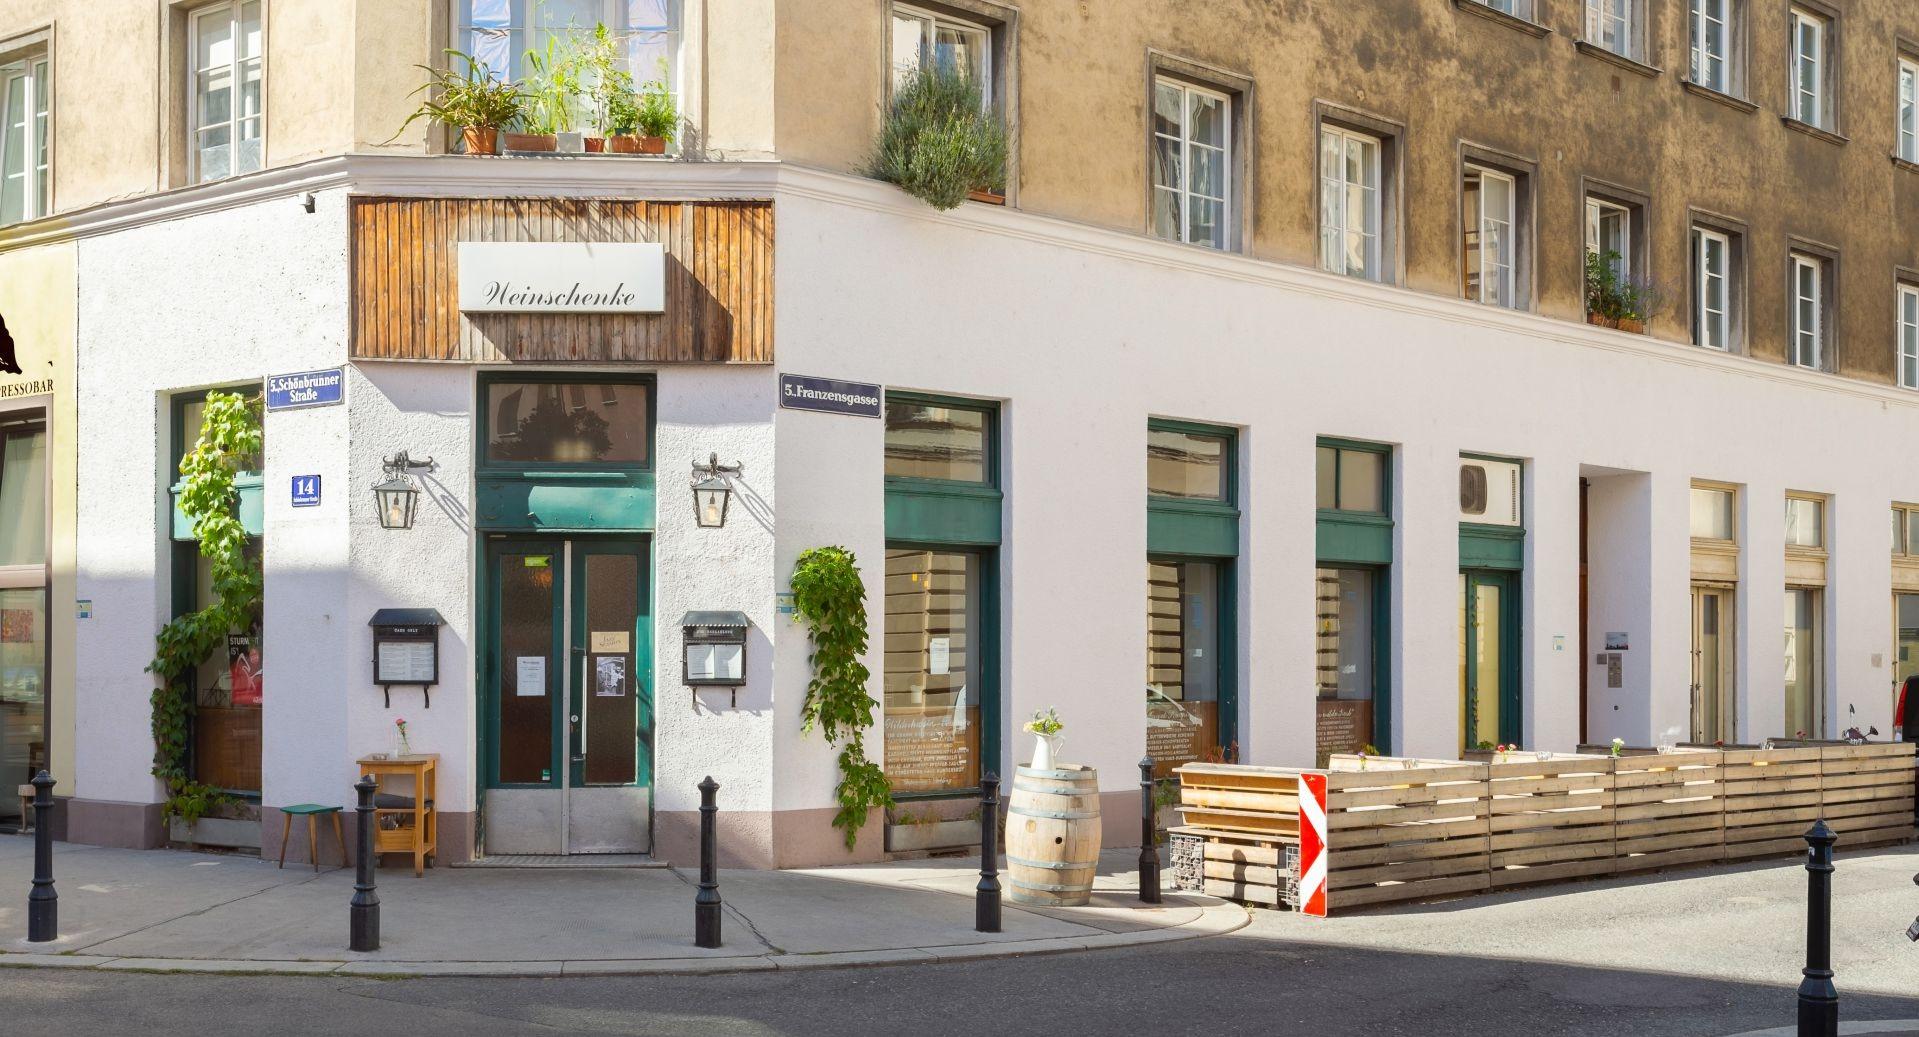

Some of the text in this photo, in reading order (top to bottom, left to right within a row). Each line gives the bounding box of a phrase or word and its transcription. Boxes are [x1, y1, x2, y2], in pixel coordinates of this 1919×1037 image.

[482, 281, 635, 306] Weinschenke
[0, 379, 54, 397] RESSOBAR
[290, 388, 318, 402] Straße
[297, 479, 315, 495] 14
